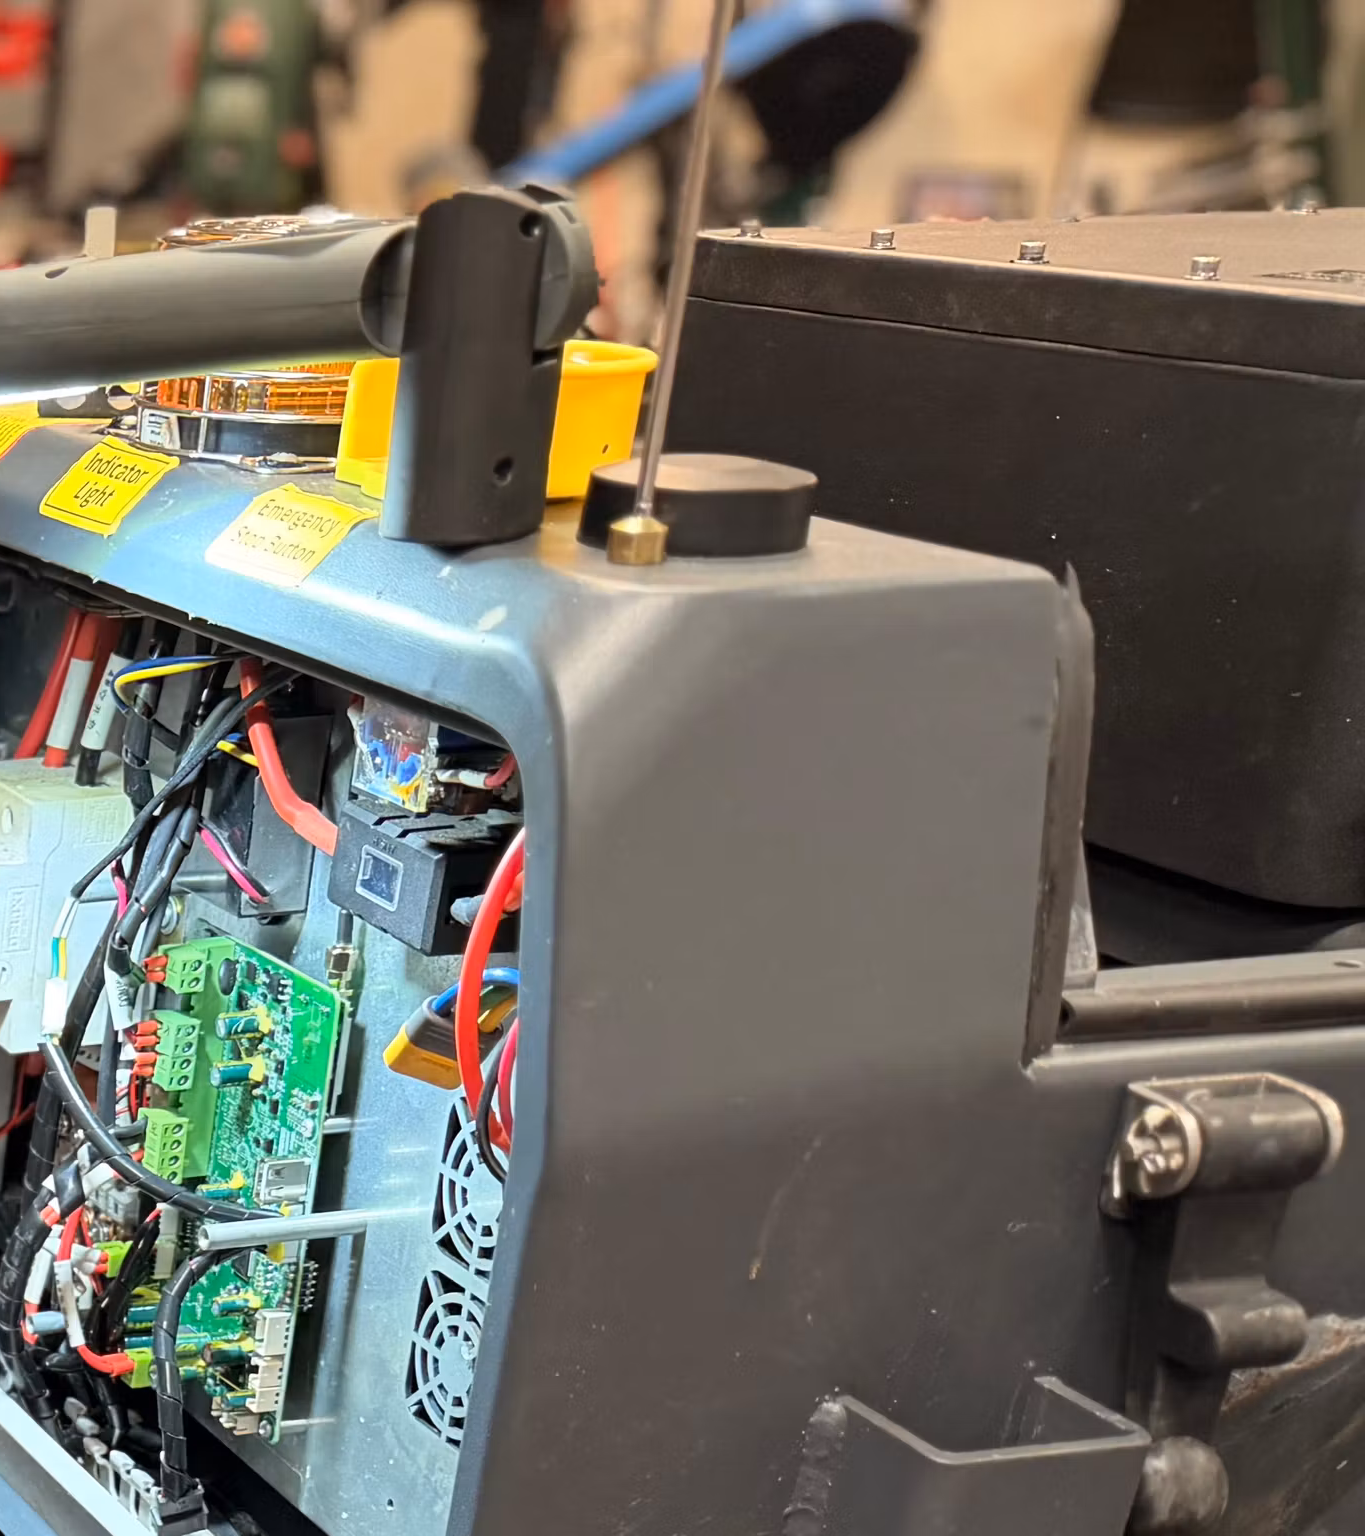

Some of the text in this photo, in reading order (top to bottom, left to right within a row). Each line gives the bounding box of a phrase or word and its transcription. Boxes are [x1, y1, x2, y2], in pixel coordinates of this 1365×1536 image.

[84, 452, 149, 484] Indicator
[73, 480, 116, 508] Light
[257, 498, 342, 539] Emergency
[262, 535, 316, 563] Button
